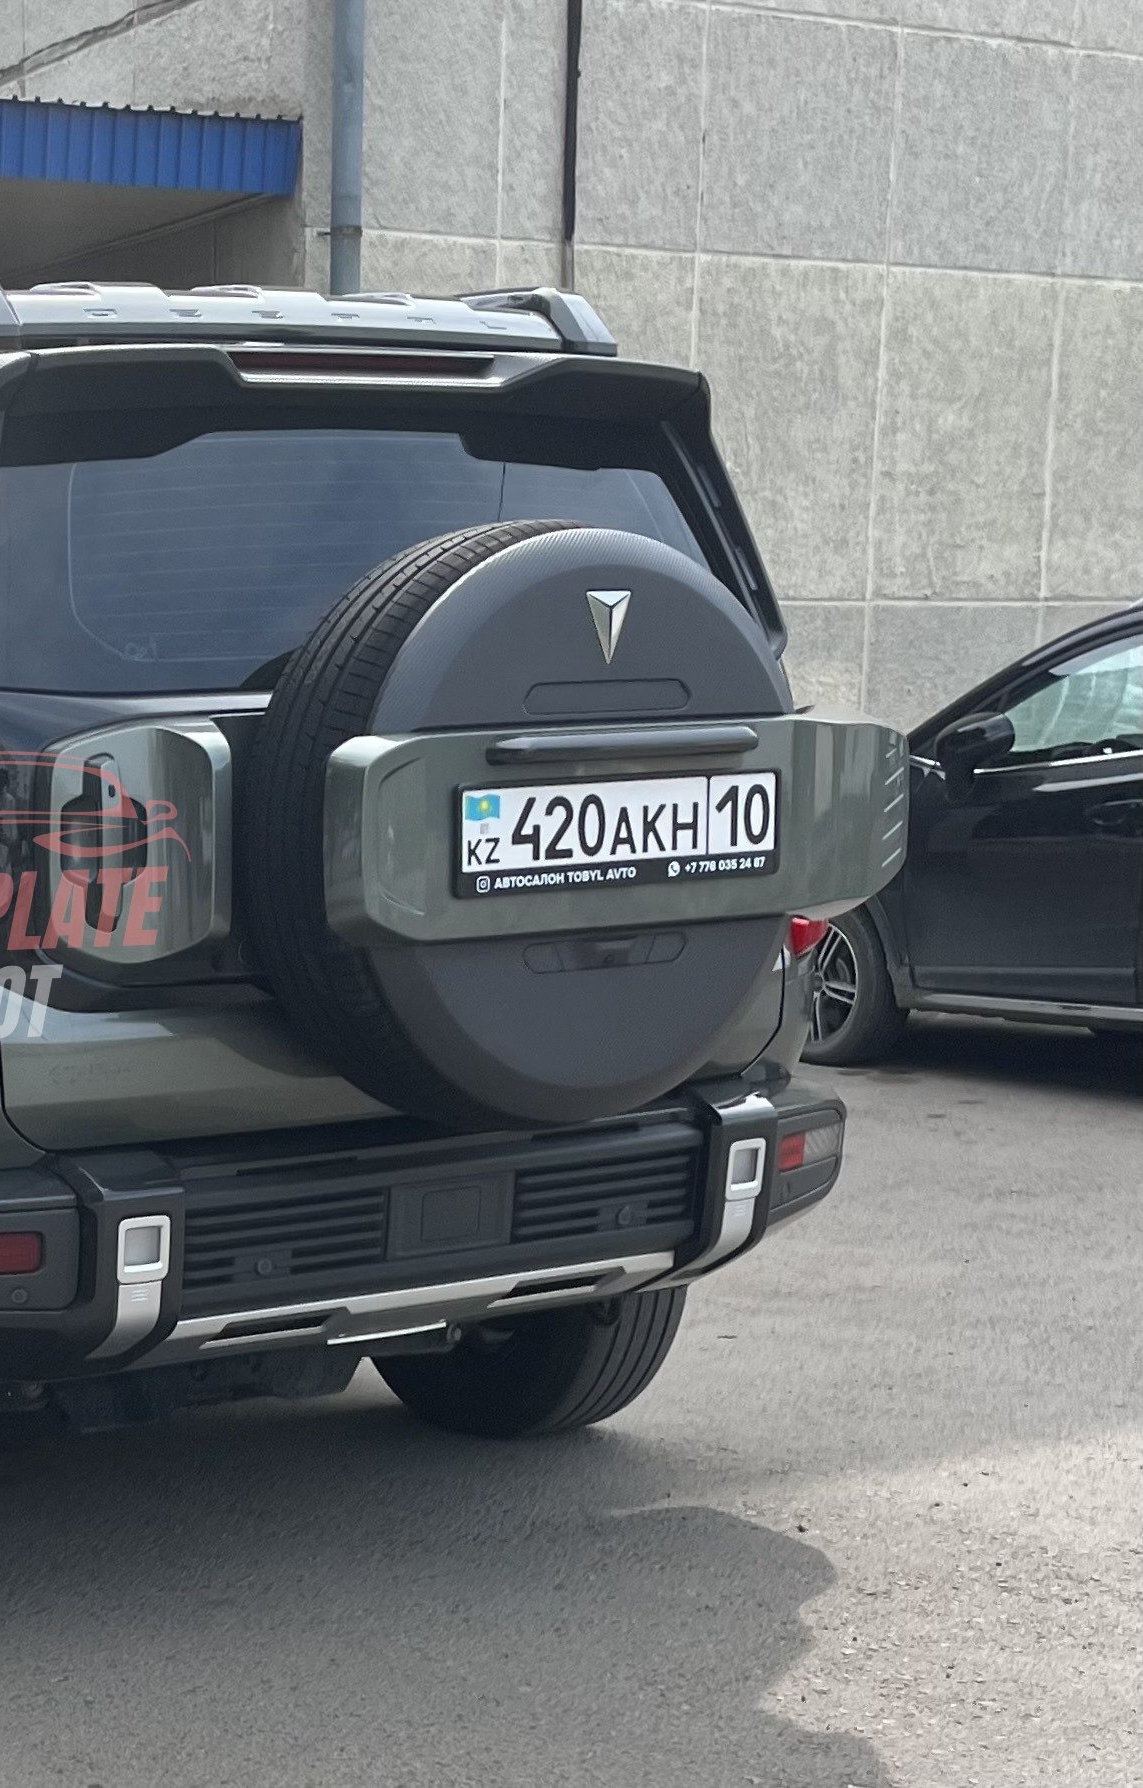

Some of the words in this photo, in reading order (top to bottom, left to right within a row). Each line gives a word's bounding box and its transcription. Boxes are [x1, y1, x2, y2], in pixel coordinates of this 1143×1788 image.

[511, 793, 699, 861] 420AKH
[715, 784, 769, 847] 10
[467, 837, 500, 866] KZ
[494, 871, 565, 889] АВТОСАЛОН
[567, 869, 603, 883] TOBYL
[606, 866, 637, 880] AVTO
[684, 861, 697, 874] +7
[738, 857, 751, 869] 24
